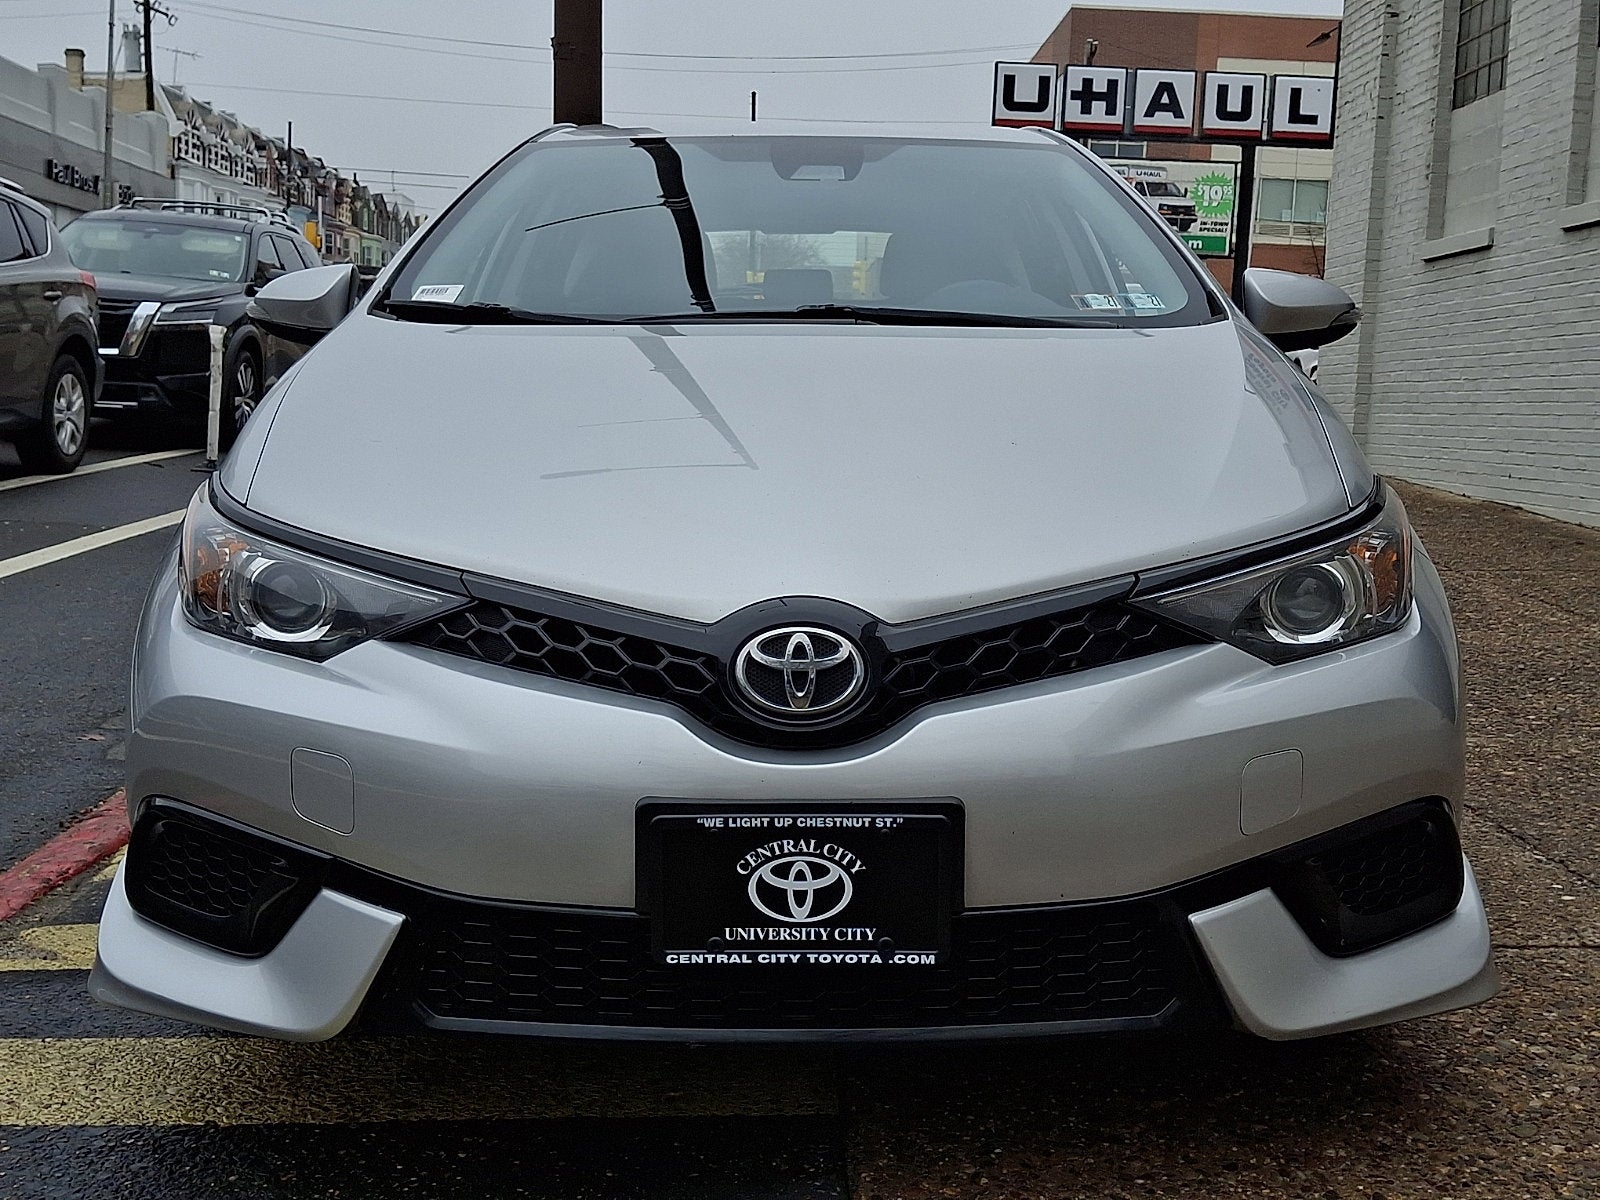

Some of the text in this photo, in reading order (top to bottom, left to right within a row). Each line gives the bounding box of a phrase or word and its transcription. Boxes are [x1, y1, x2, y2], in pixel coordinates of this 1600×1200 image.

[1002, 73, 1319, 126] U-HAUL
[728, 818, 771, 828] LIGHT
[774, 818, 793, 828] UP
[796, 818, 872, 828] CHESTNUT
[736, 838, 866, 875] CENTRAL CITY
[724, 927, 877, 941] UNIVERSITY CITY
[666, 953, 937, 965] CENTRAL CITY TOYOTA .COM
